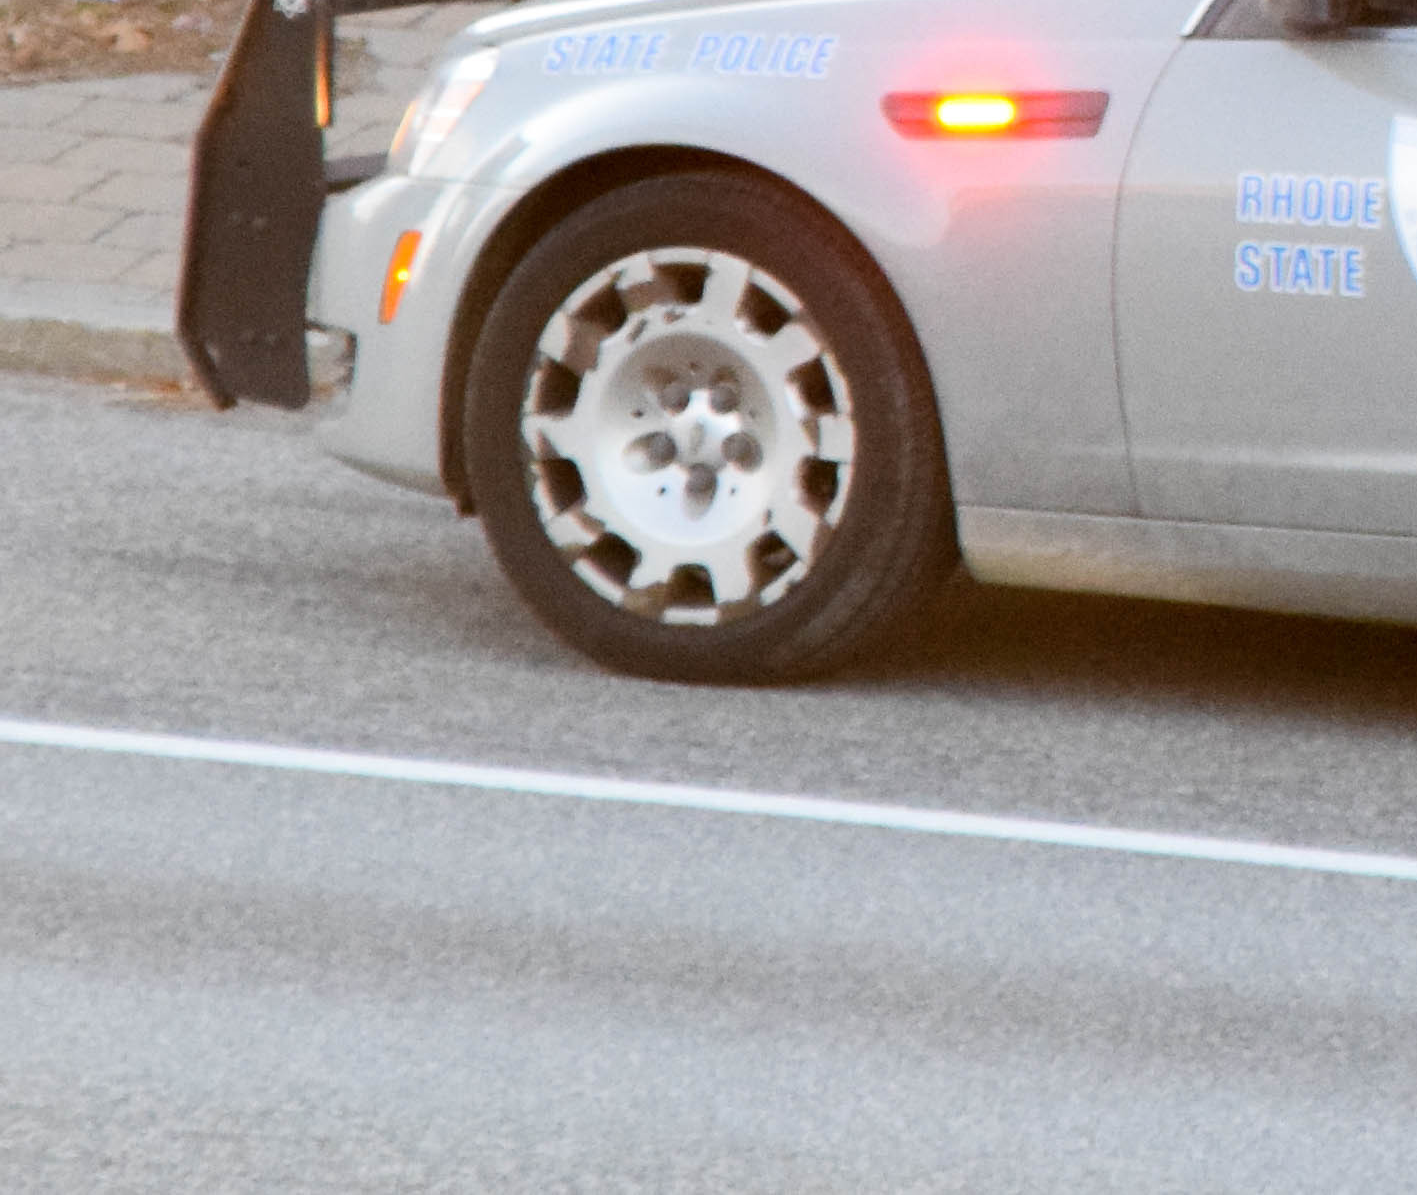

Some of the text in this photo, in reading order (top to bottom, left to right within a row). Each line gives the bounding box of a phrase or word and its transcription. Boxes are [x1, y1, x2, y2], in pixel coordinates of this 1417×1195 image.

[543, 32, 837, 79] STATE POLICE
[1236, 172, 1383, 227] RHODE
[1235, 242, 1365, 296] STATE
